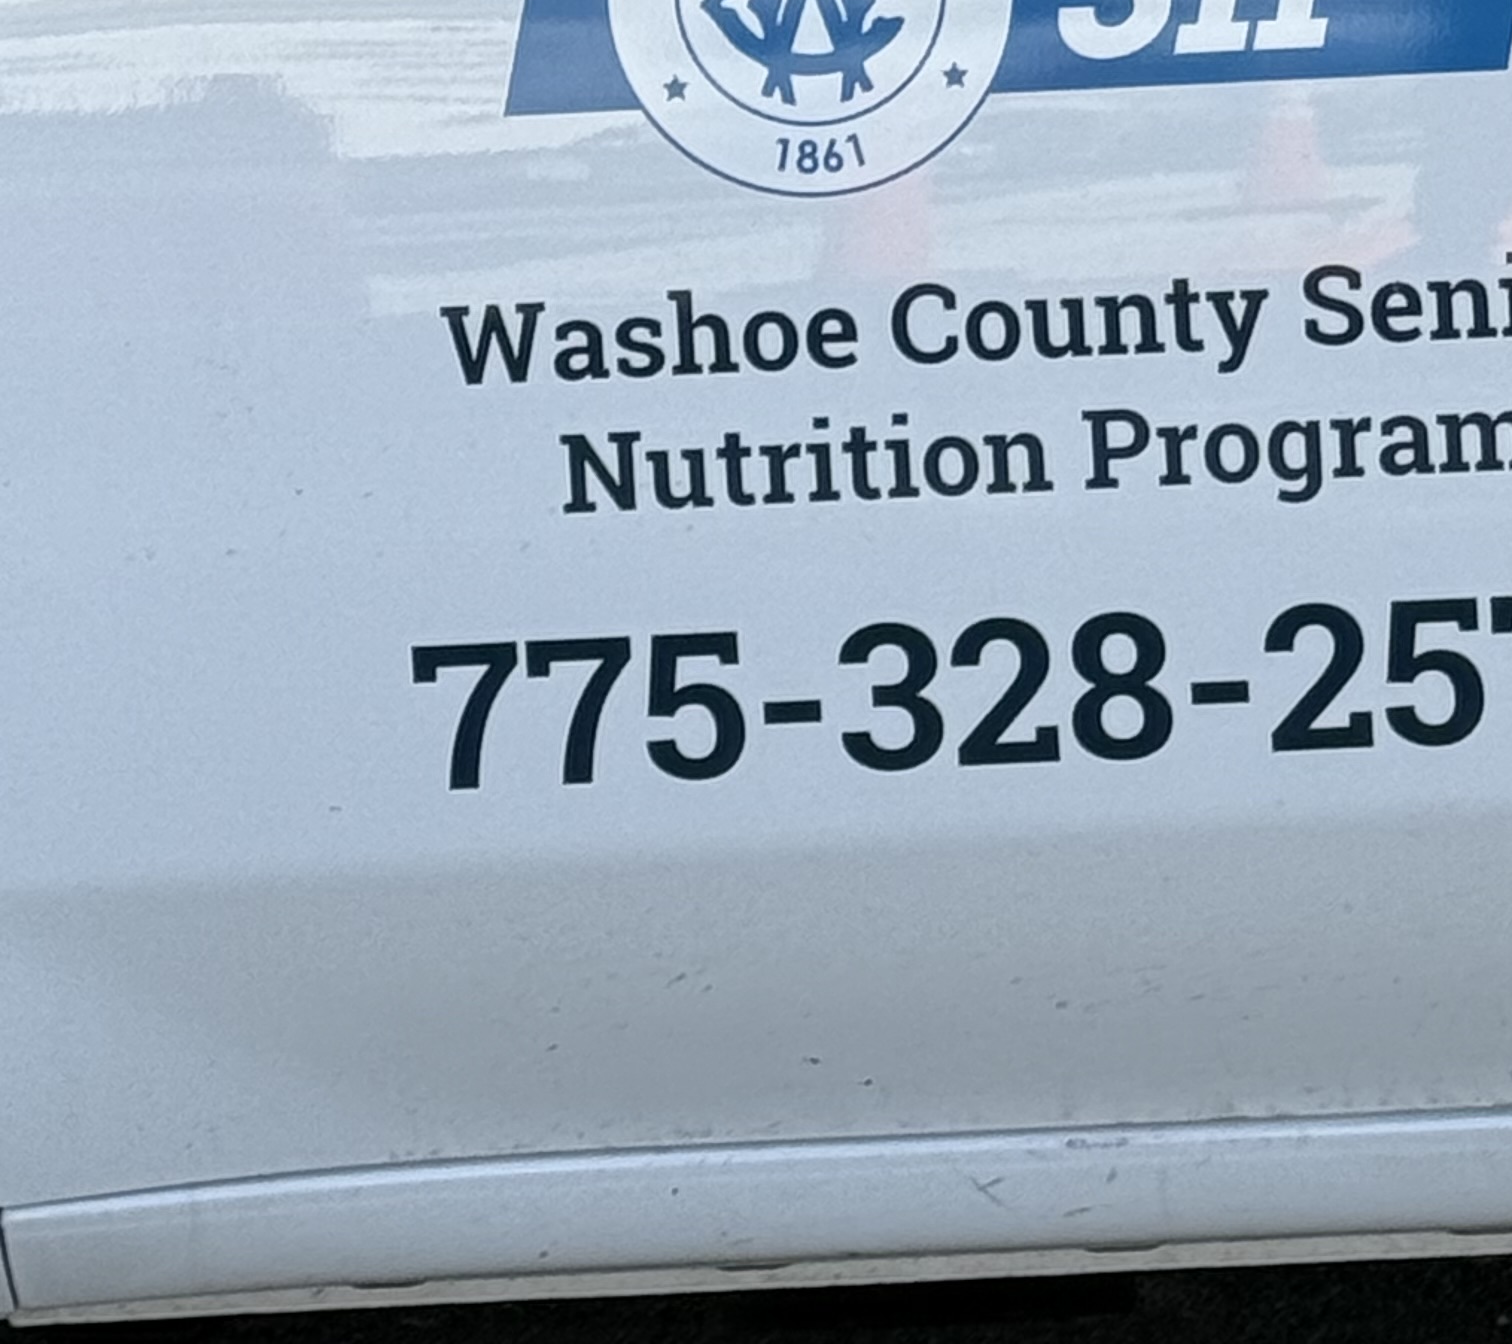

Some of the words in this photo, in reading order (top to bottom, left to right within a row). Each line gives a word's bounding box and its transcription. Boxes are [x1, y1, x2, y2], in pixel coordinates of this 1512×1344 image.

[776, 133, 867, 175] 1861
[439, 282, 859, 386] Washoe
[891, 278, 1270, 374] County
[559, 412, 1055, 514] Nutrition
